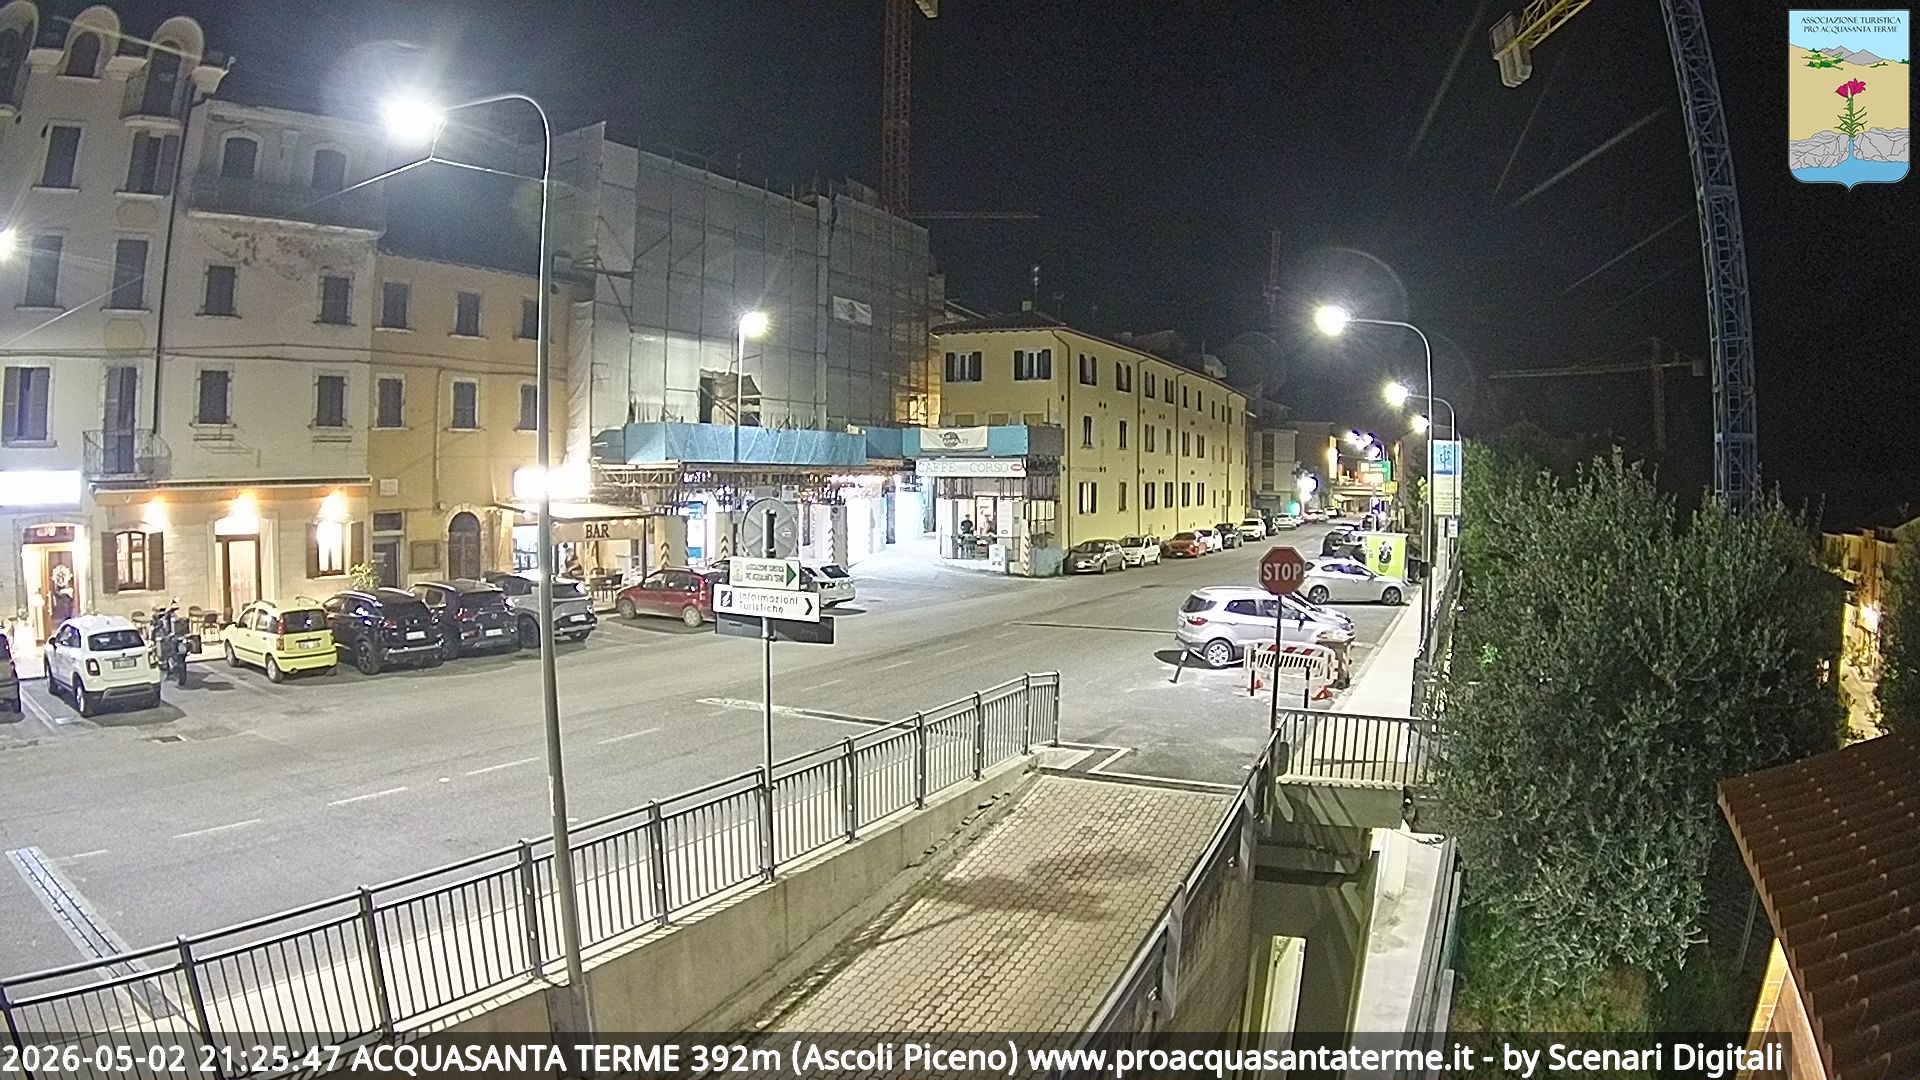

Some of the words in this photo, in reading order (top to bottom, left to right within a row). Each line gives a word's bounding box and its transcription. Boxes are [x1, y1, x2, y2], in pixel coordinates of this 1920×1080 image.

[969, 462, 1009, 473] CORSO
[585, 523, 610, 539] BAR
[1263, 562, 1302, 581] STOP
[739, 591, 799, 605] Informazioni
[739, 600, 784, 613] Turistiche
